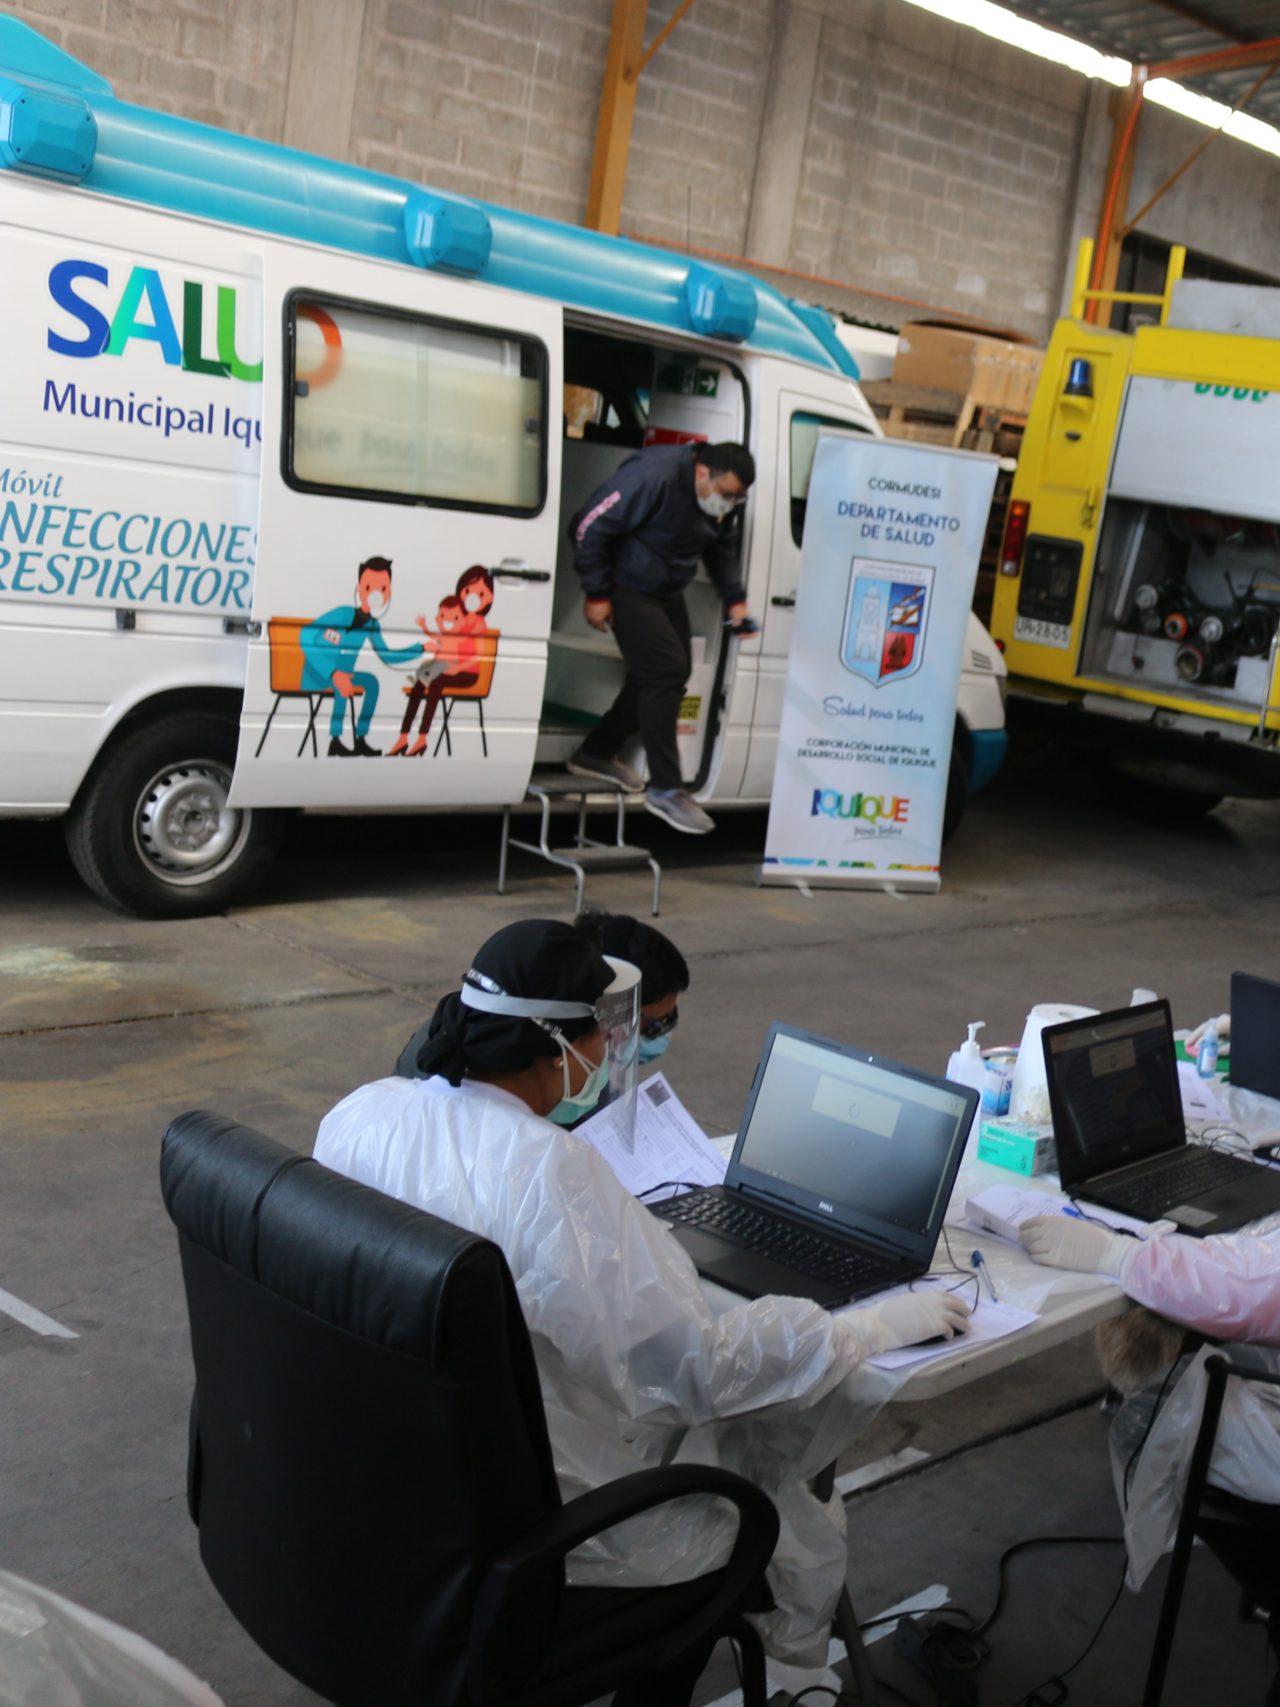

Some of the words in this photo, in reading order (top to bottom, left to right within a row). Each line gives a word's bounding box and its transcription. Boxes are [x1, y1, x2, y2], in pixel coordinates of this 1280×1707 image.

[43, 379, 214, 438] Municipal
[868, 477, 942, 499] CORMUDESI
[837, 500, 960, 532] DEPARTAMENTO
[0, 500, 258, 566] NFECCIONE
[860, 523, 880, 540] DE
[885, 527, 935, 547] SALUD
[0, 551, 253, 609] ESPIRATOR
[823, 696, 865, 717] Salud
[869, 707, 893, 721] para
[797, 748, 854, 761] DESARROLLO
[856, 752, 886, 765] SOCIAL
[889, 755, 899, 766] DE
[901, 757, 936, 769] IQUIQUE
[873, 743, 917, 756] MUNICIPAL
[920, 746, 930, 757] DE
[811, 788, 910, 823] IQUIQUE
